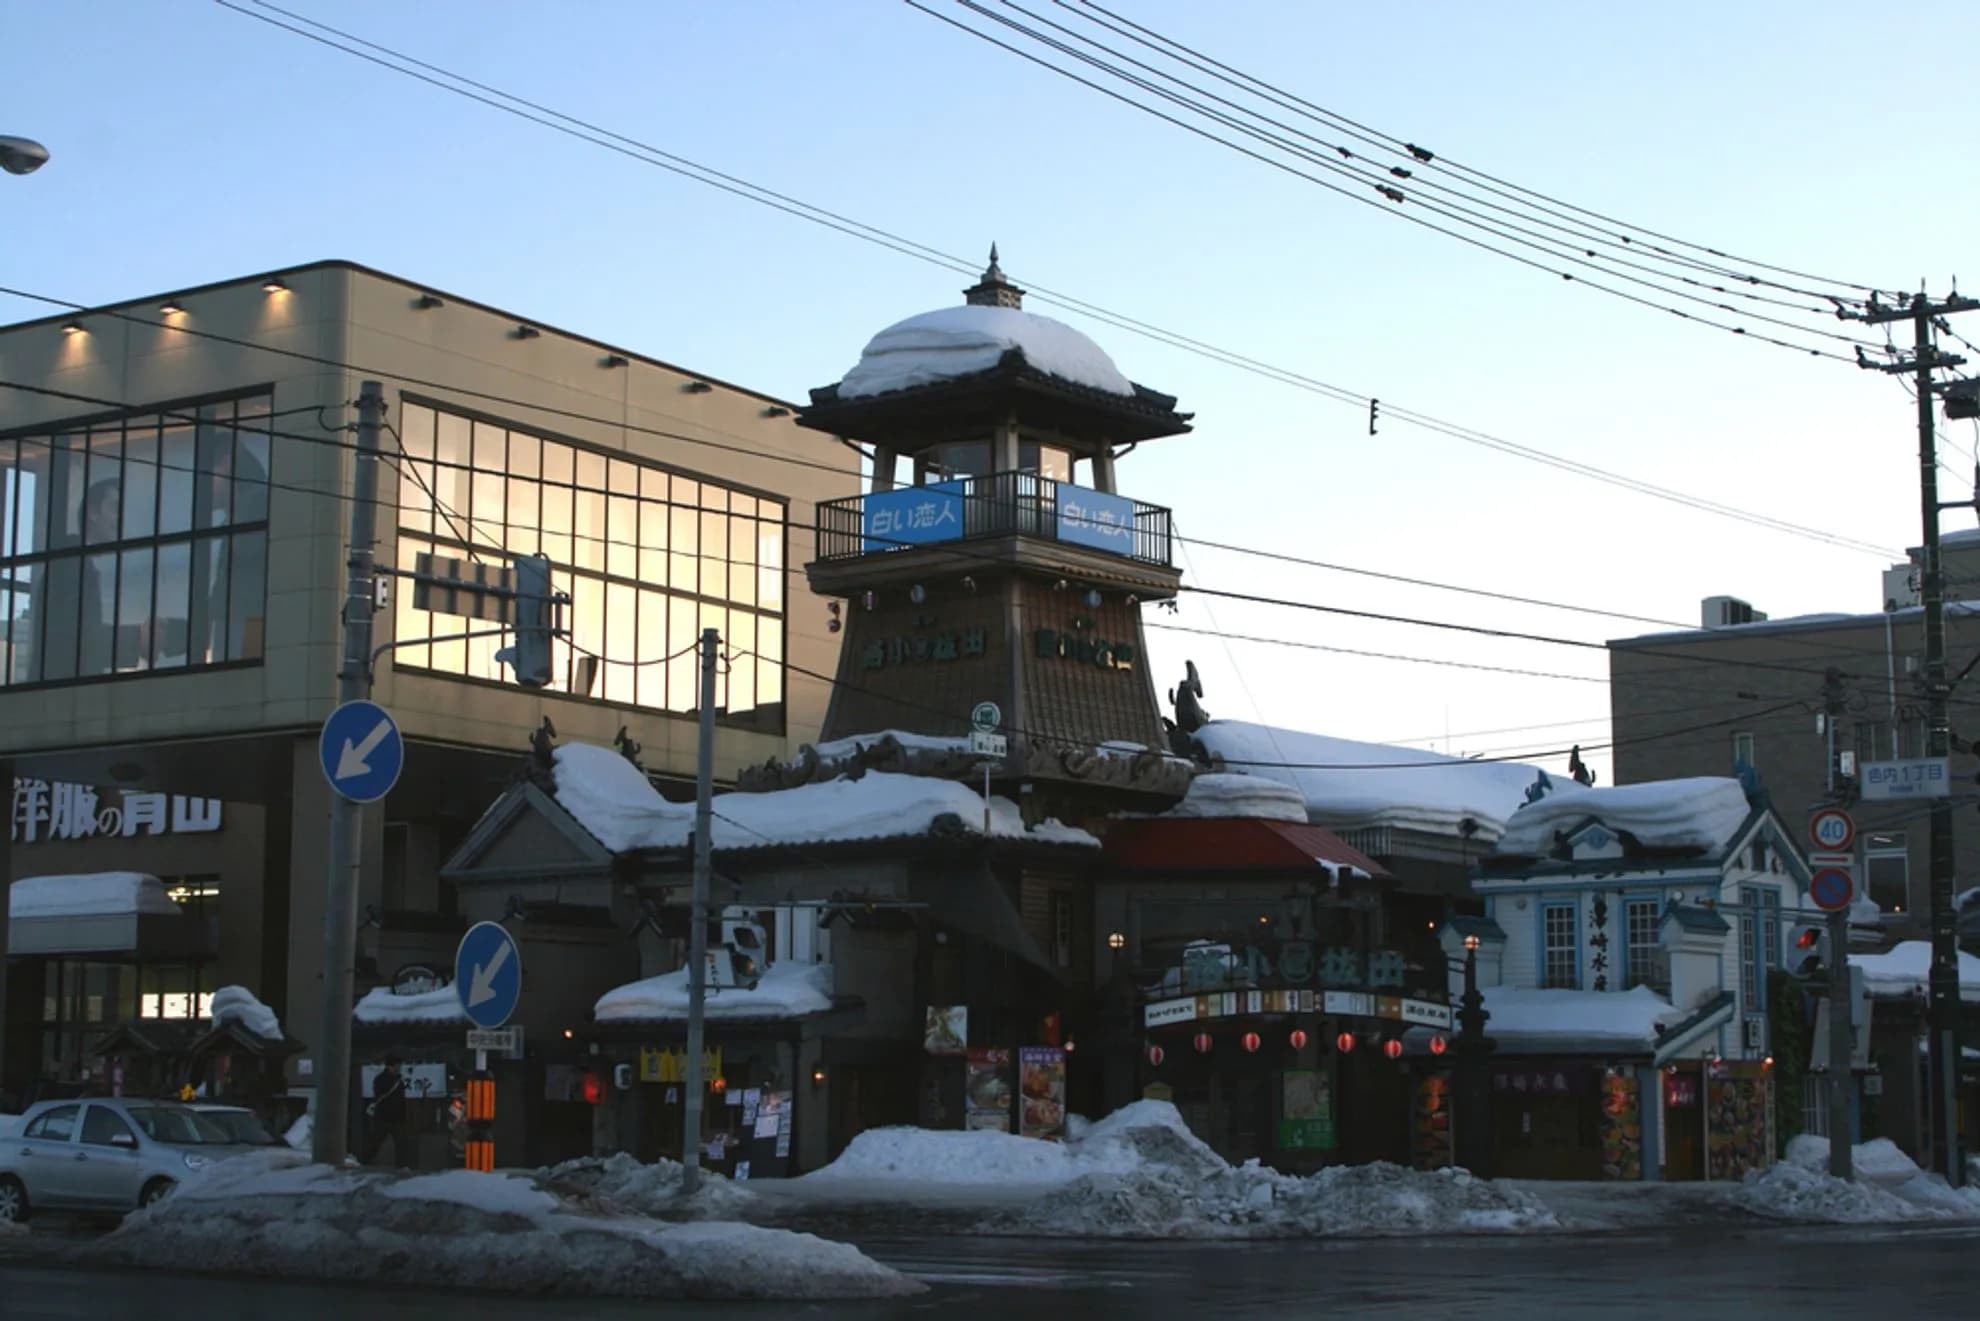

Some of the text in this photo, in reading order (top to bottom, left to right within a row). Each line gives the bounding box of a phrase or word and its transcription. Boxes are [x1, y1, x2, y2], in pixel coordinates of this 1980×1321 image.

[871, 499, 956, 535] 白い恋人
[1062, 500, 1131, 540] 白い恋人
[1820, 819, 1845, 840] 40
